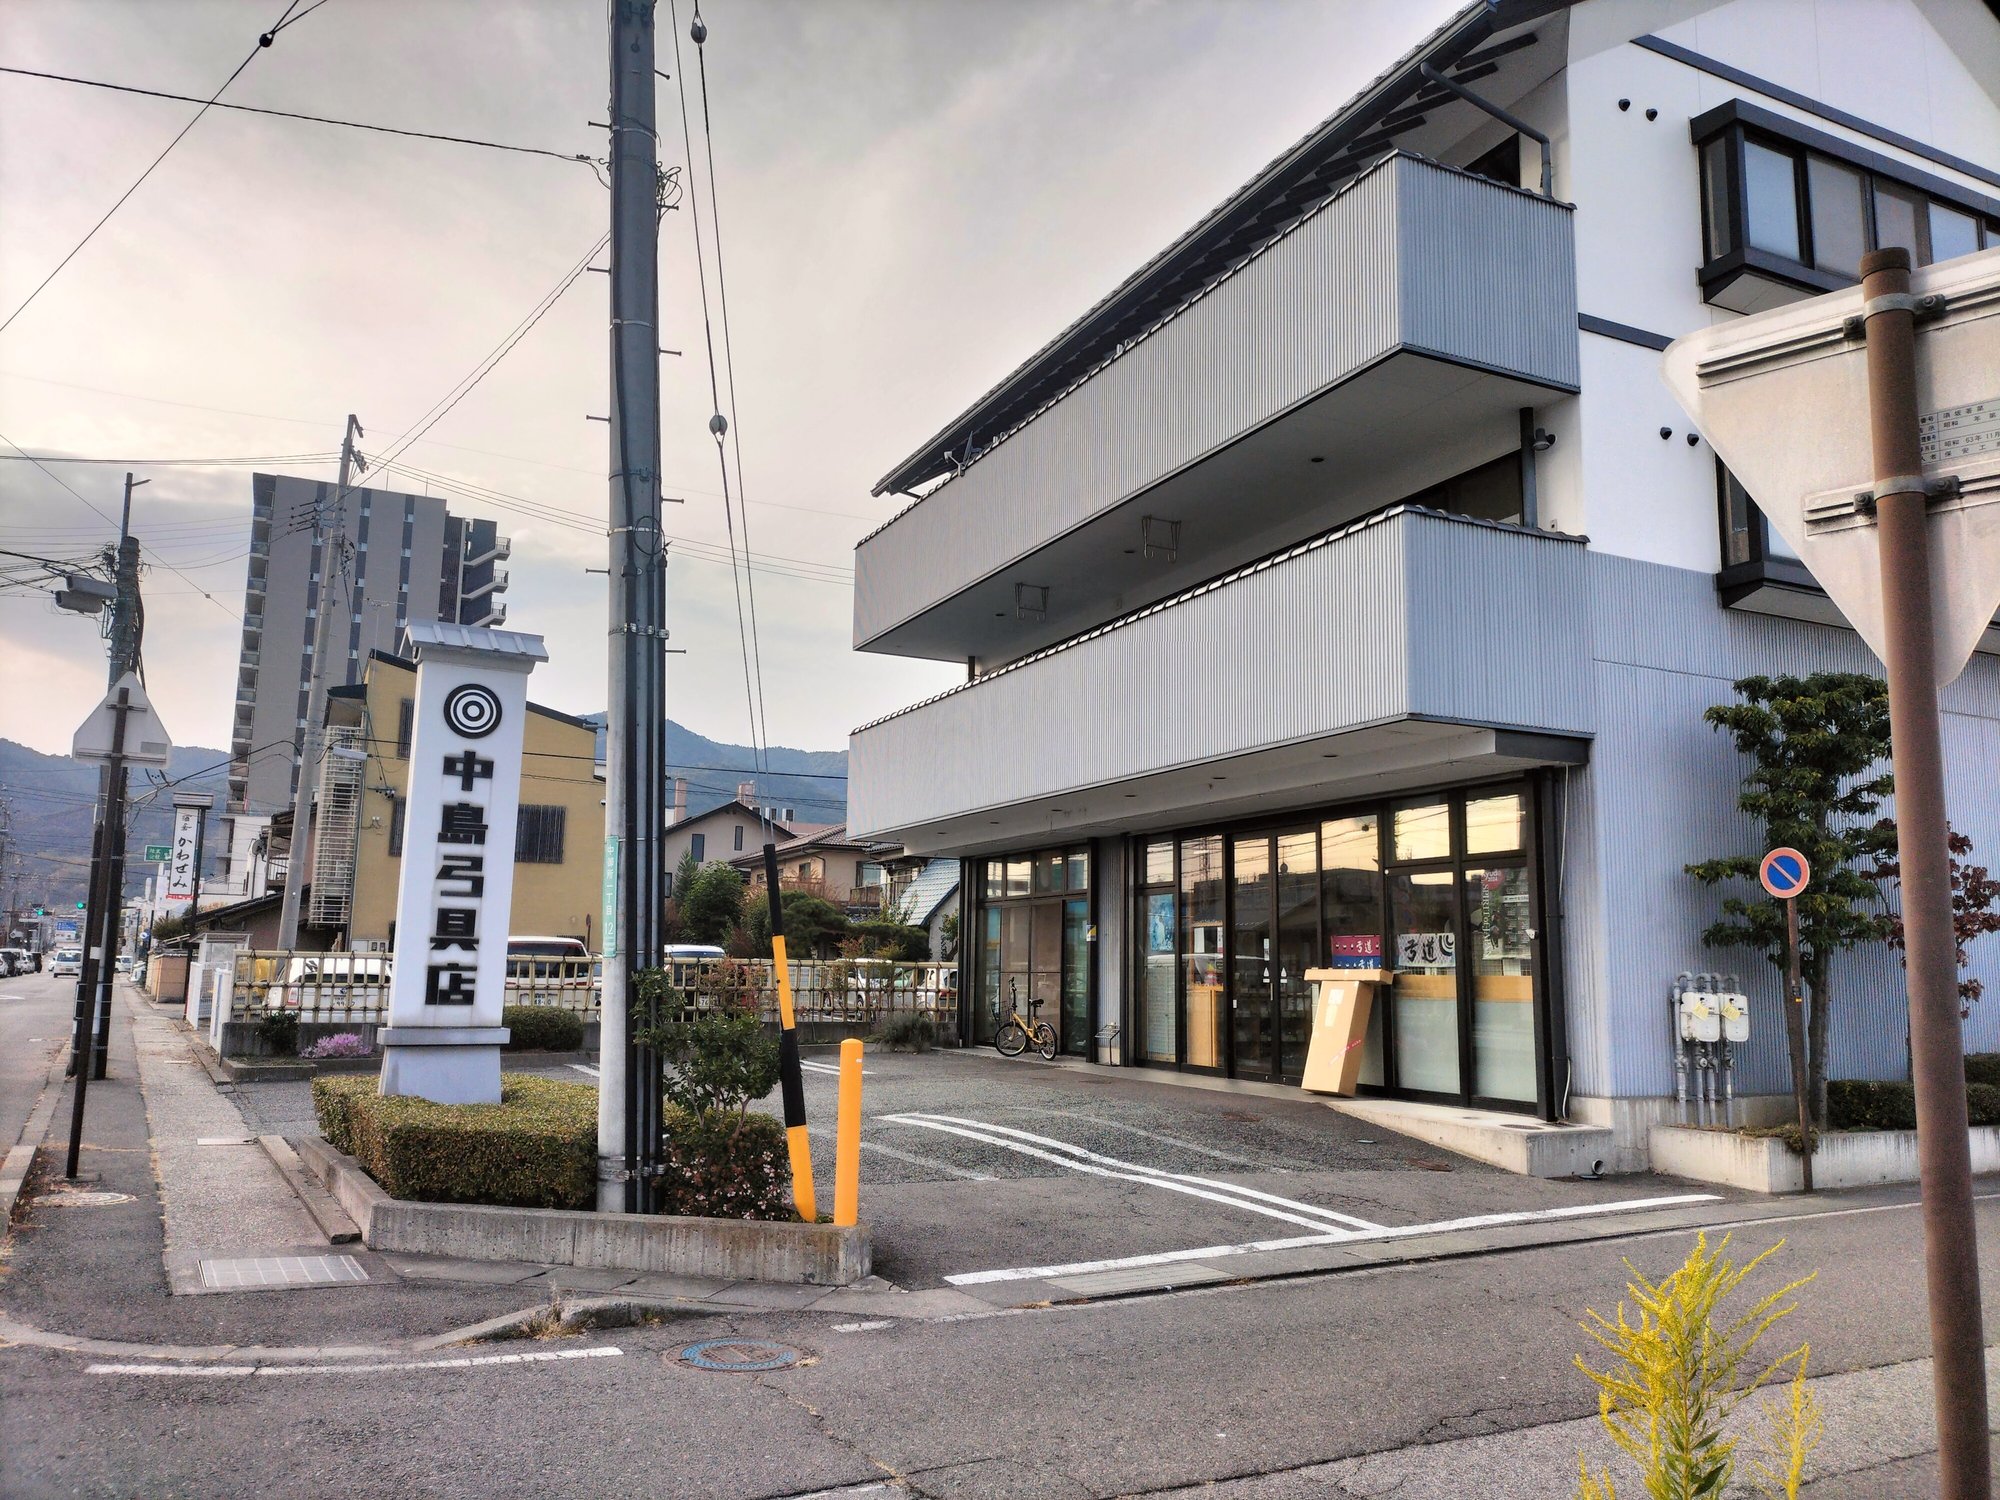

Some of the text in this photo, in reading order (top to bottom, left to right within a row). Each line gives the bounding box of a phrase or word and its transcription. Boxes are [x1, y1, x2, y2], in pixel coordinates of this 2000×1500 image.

[172, 836, 193, 888] かわせみ
[425, 750, 494, 1005] 中島弓具店
[1355, 940, 1373, 953] 弓道
[1404, 937, 1437, 963] 弓道
